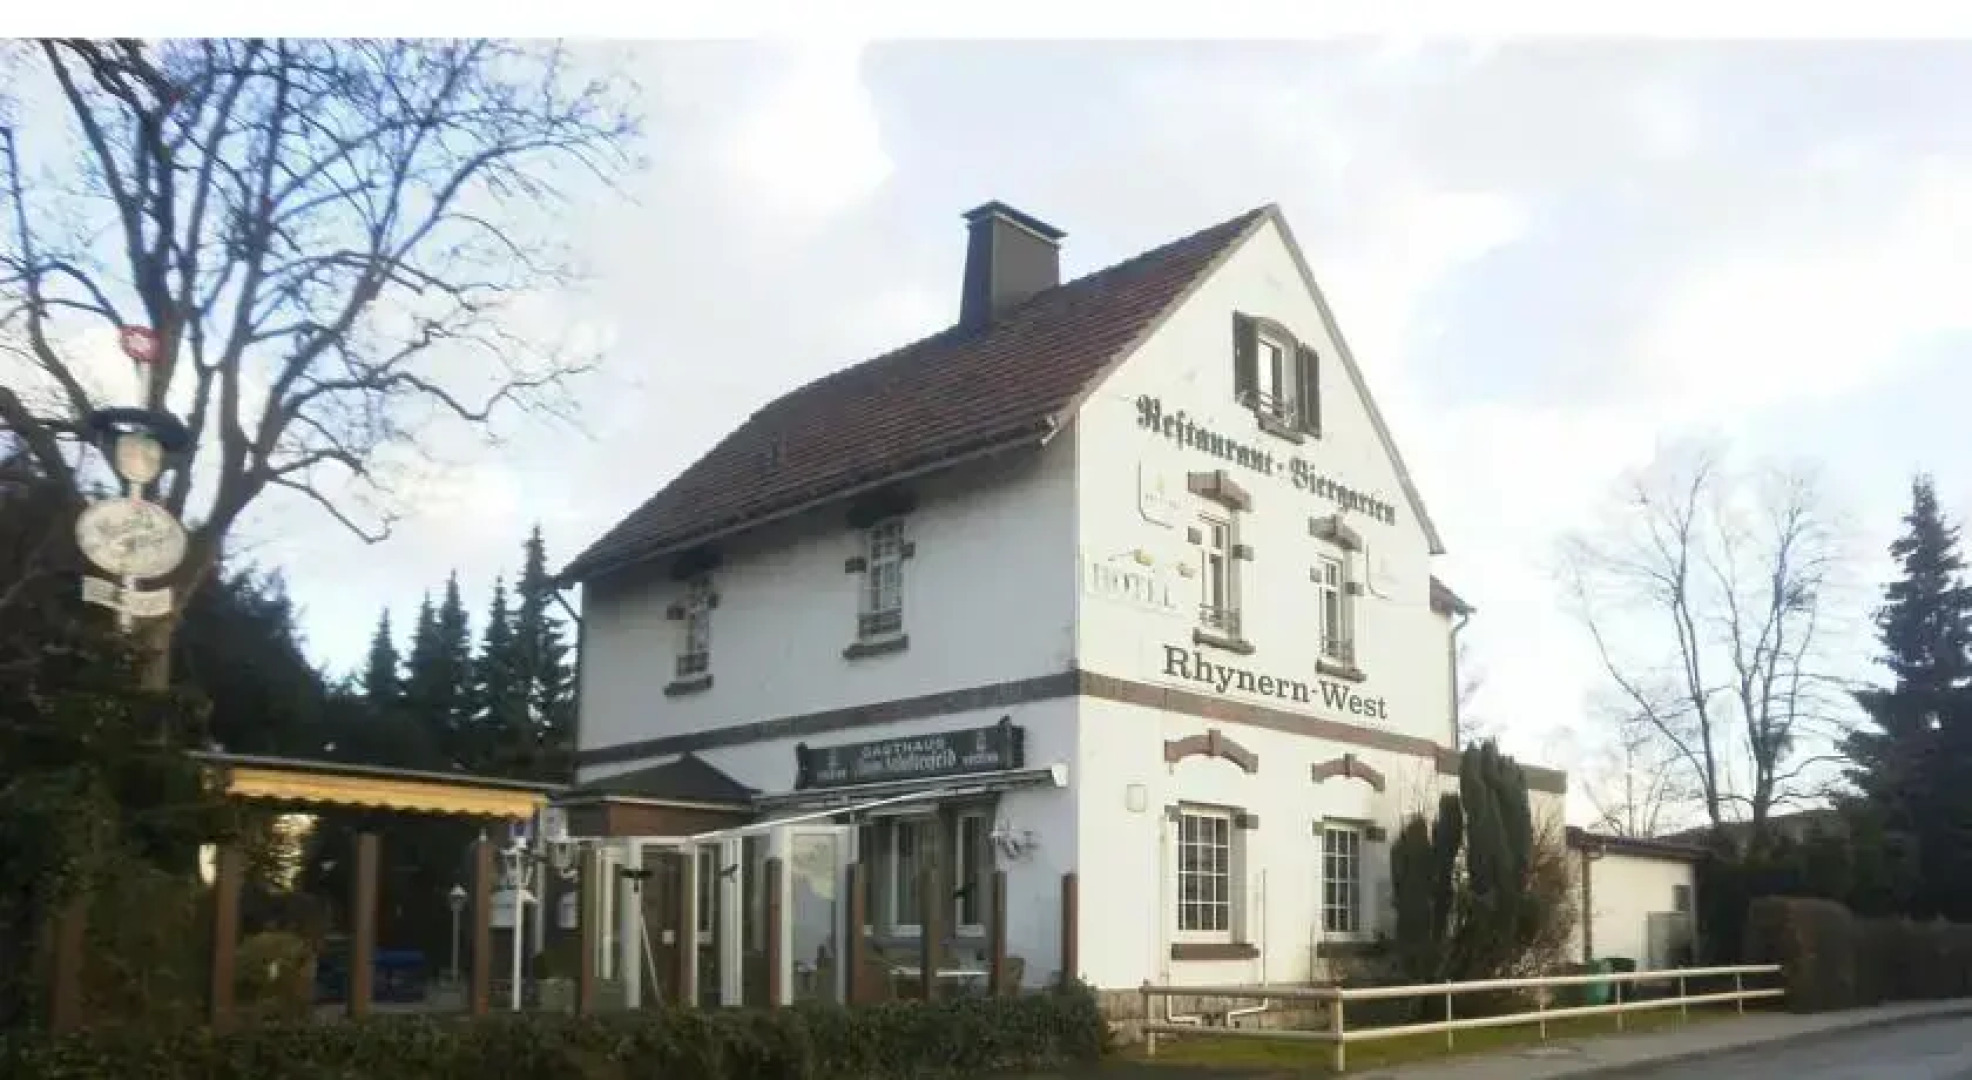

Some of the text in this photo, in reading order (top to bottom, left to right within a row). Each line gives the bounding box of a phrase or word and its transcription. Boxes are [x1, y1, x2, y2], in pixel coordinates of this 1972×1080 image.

[1289, 456, 1395, 526] Biergarten
[1163, 644, 1388, 720] Rhynern-West
[861, 734, 946, 761] GASTHAUS
